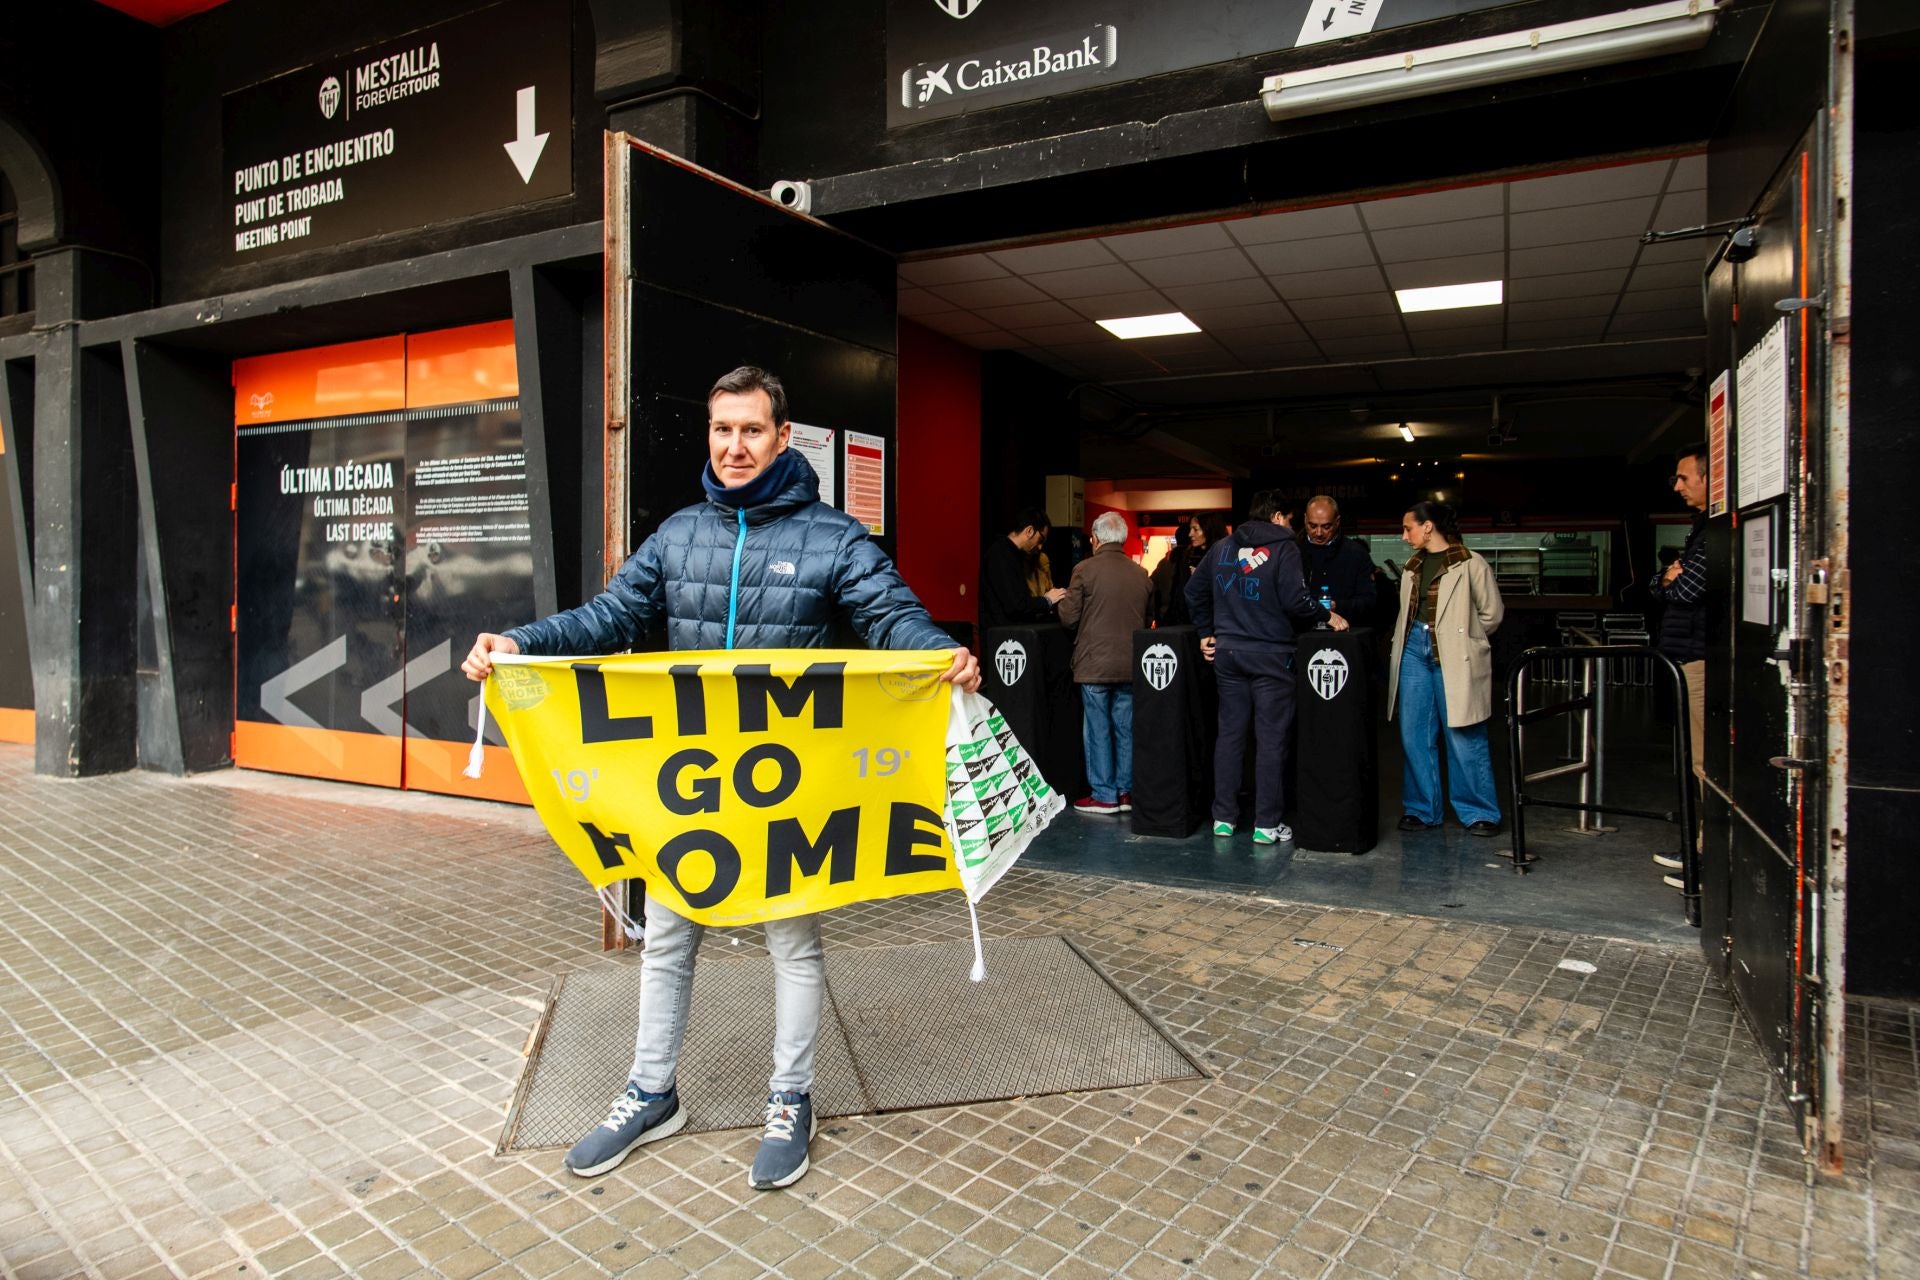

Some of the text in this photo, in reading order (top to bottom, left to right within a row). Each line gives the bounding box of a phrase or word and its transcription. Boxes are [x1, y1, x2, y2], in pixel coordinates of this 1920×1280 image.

[356, 42, 440, 94] MESTALLA
[956, 36, 1101, 91] CaixaBank
[356, 71, 440, 111] FOREVERTOUR
[235, 128, 394, 195] PUNTO DE ENCUENTRO
[235, 178, 344, 226] PUNT DE TROBADA
[235, 216, 311, 252] MEETING POINT
[280, 464, 331, 494] ÚLTIMA
[334, 459, 394, 491] DÉCADA
[314, 495, 350, 517] ÚLTIMA
[352, 493, 394, 515] DÈCADA
[326, 523, 350, 542] LAST
[352, 522, 394, 541] DECADE
[570, 661, 847, 744] LIM
[656, 743, 801, 815] GO
[851, 747, 911, 778] 19'
[578, 802, 947, 909] HOME
